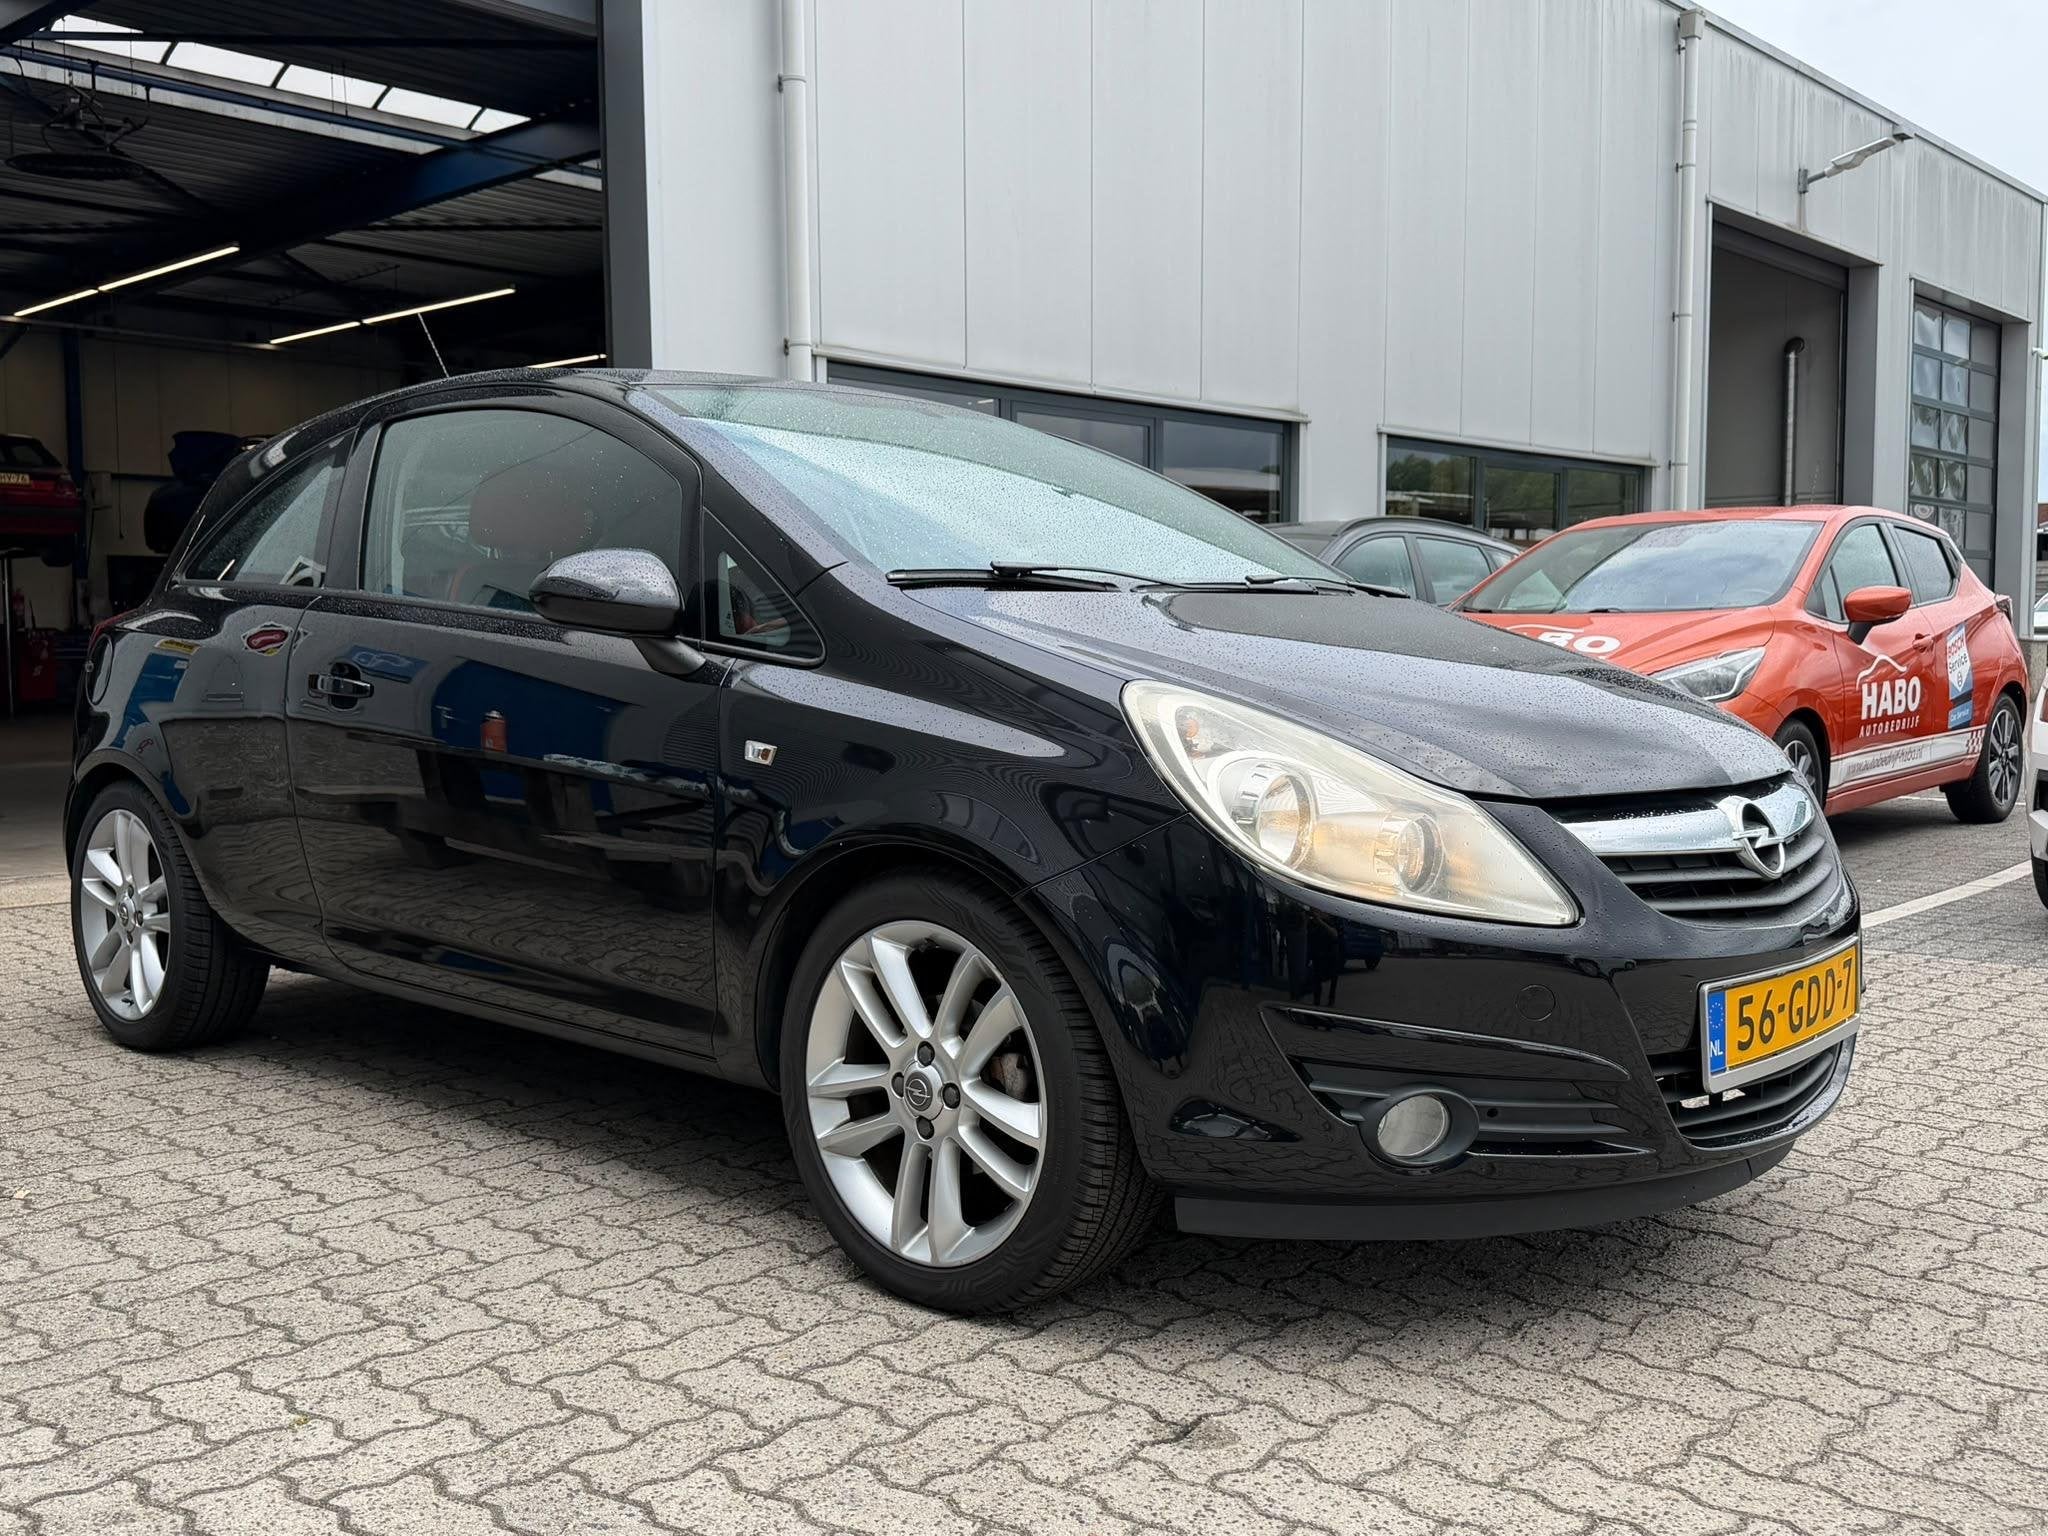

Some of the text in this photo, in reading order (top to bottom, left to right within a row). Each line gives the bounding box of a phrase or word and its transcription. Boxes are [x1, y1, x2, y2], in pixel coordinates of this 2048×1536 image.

[1538, 631, 1621, 653] BO
[1949, 652, 1968, 674] Service
[1861, 676, 1921, 720] HABO
[1859, 715, 1920, 738] AUTOBEDRIJF
[1737, 957, 1852, 1051] 56-GDD-7
[1710, 1040, 1723, 1057] NL
